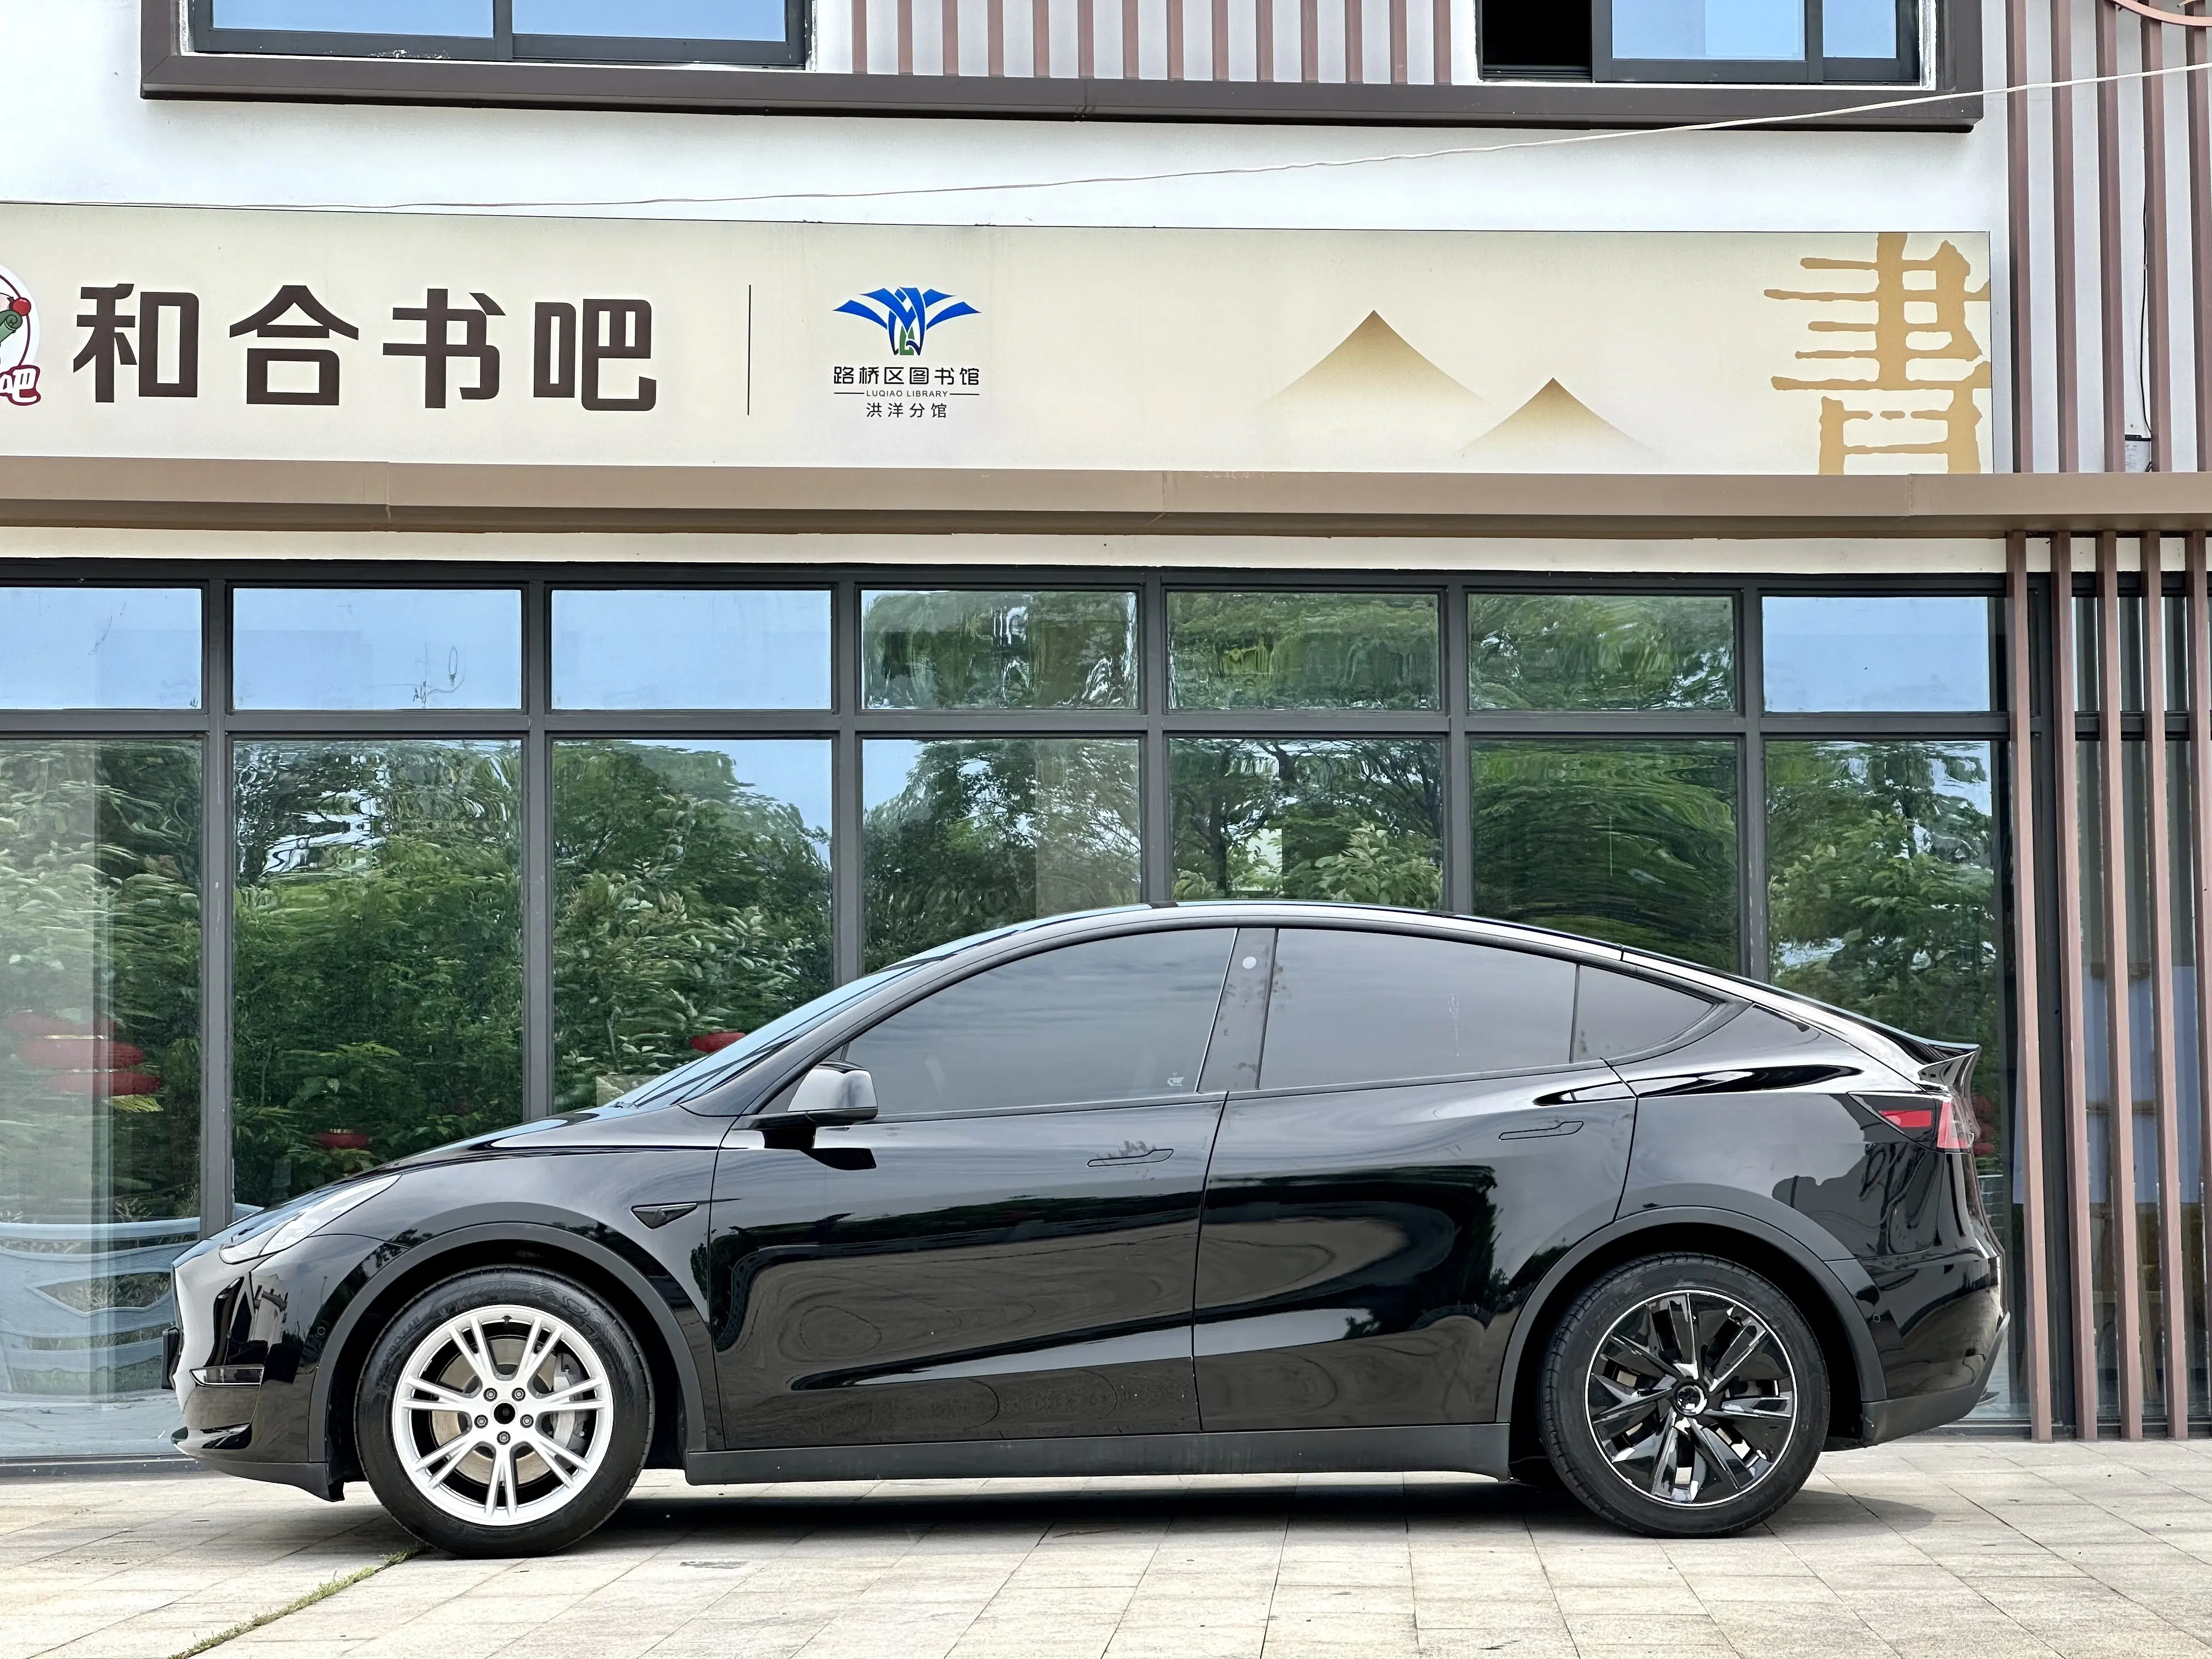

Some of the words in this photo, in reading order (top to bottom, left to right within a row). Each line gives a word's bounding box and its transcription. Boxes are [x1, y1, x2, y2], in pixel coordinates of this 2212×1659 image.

[74, 283, 657, 412] 和合书吧
[833, 366, 979, 385] 路桥区图书馆
[866, 402, 947, 418] 洪洋分馆
